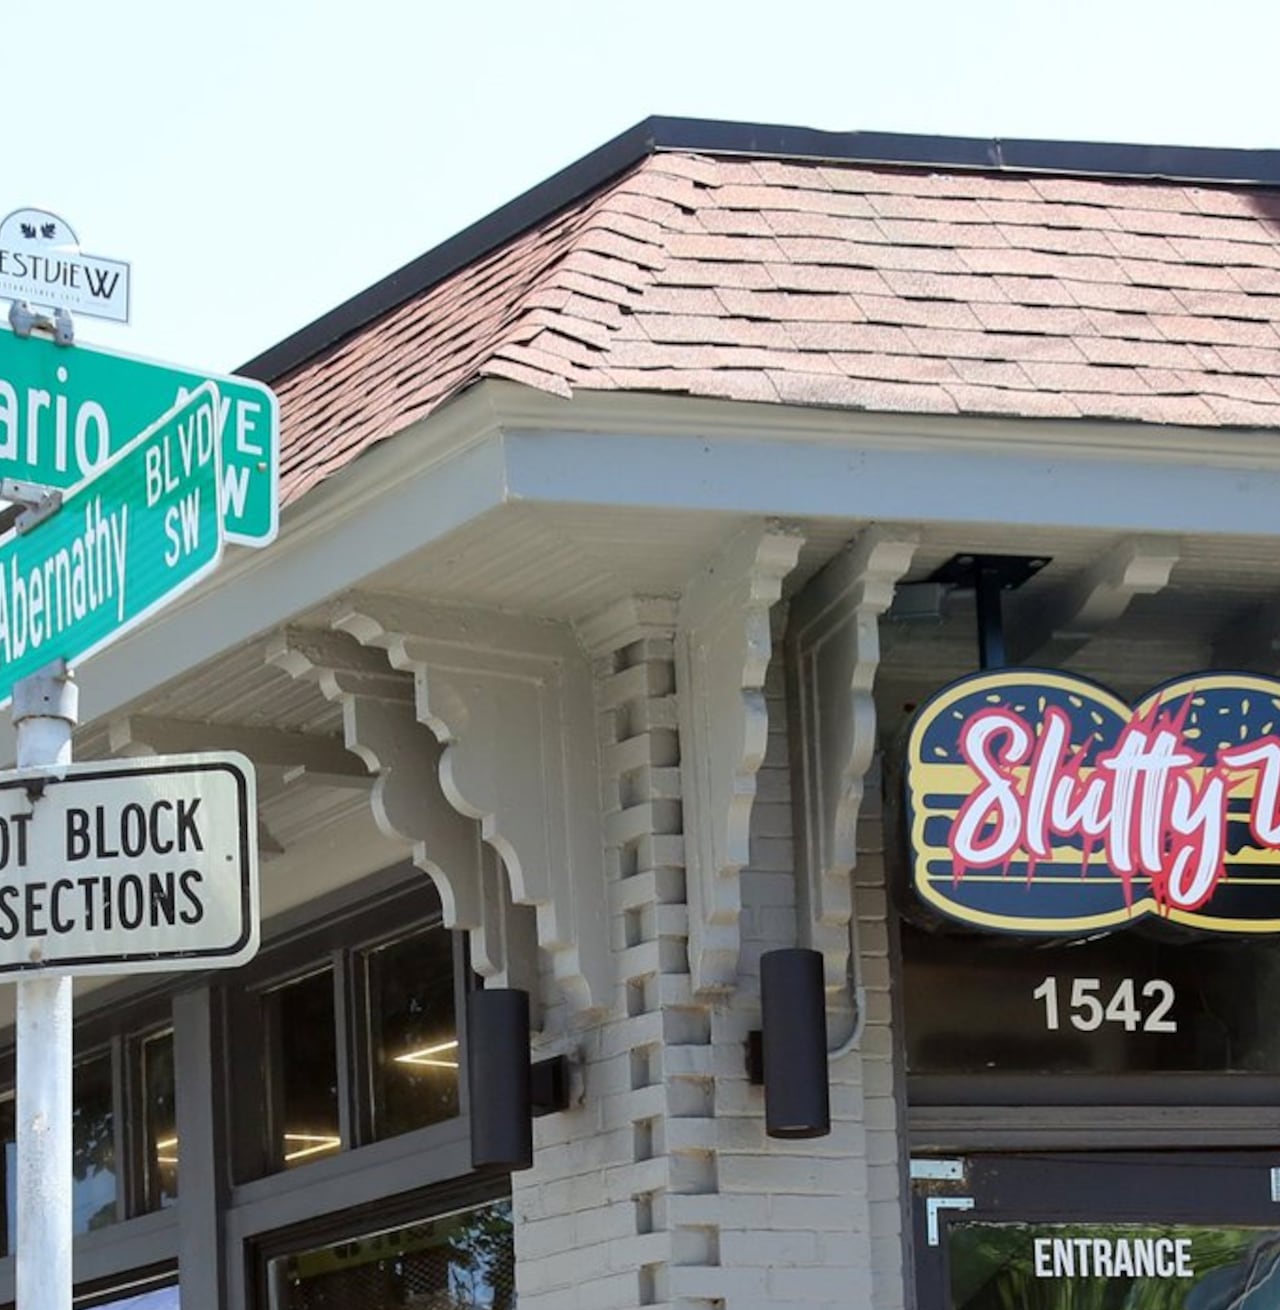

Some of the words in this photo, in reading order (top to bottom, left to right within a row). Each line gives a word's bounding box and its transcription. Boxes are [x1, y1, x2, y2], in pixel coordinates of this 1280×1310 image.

[145, 402, 213, 508] BLVD
[164, 487, 201, 568] SW
[66, 798, 204, 862] BLOCK
[953, 712, 1225, 907] Slutty
[1033, 976, 1178, 1033] 1542
[1033, 1237, 1194, 1278] ENTRANCE
